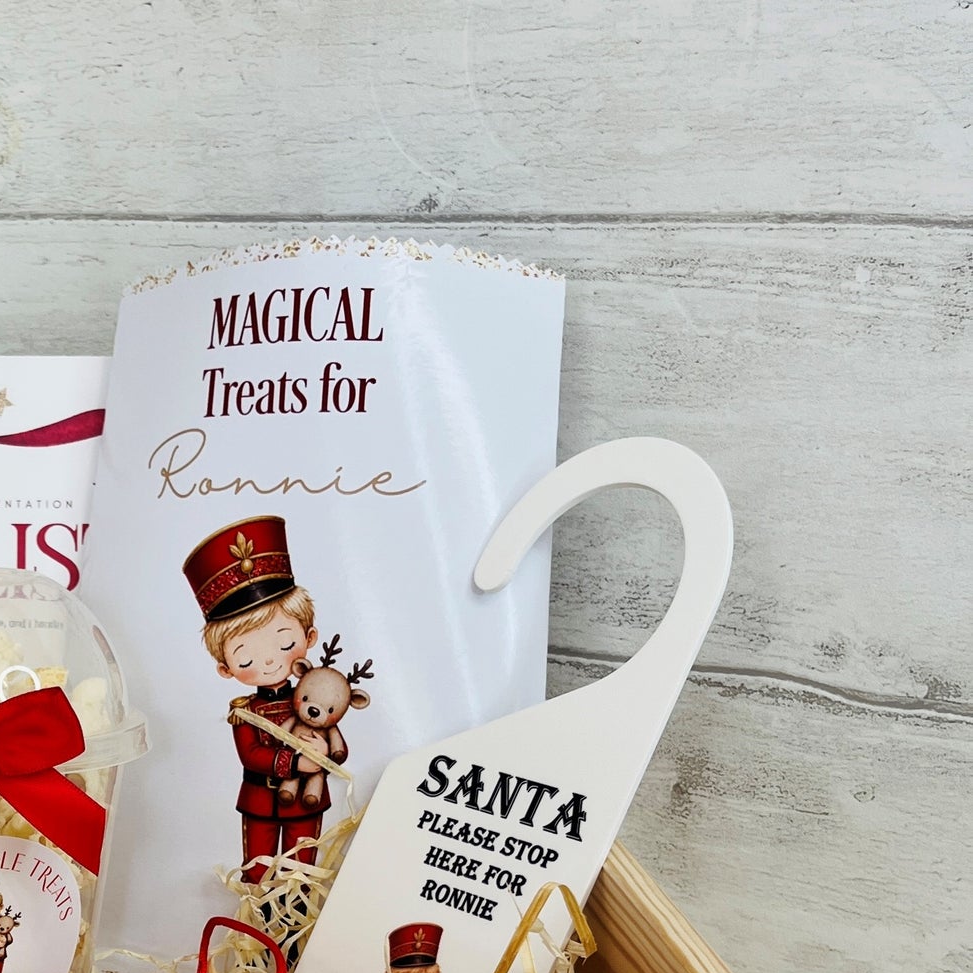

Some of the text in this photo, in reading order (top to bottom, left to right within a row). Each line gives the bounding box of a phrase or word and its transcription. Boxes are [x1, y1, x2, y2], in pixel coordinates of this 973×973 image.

[207, 286, 384, 350] MAGICAL
[202, 361, 377, 418] Treats for
[148, 428, 427, 499] Ronnie
[416, 755, 587, 842] SANTA
[417, 810, 560, 869] PLEASE STOP
[29, 857, 73, 921] TREATS
[419, 878, 499, 922] RONNIE
[423, 845, 528, 897] HERE FOR
